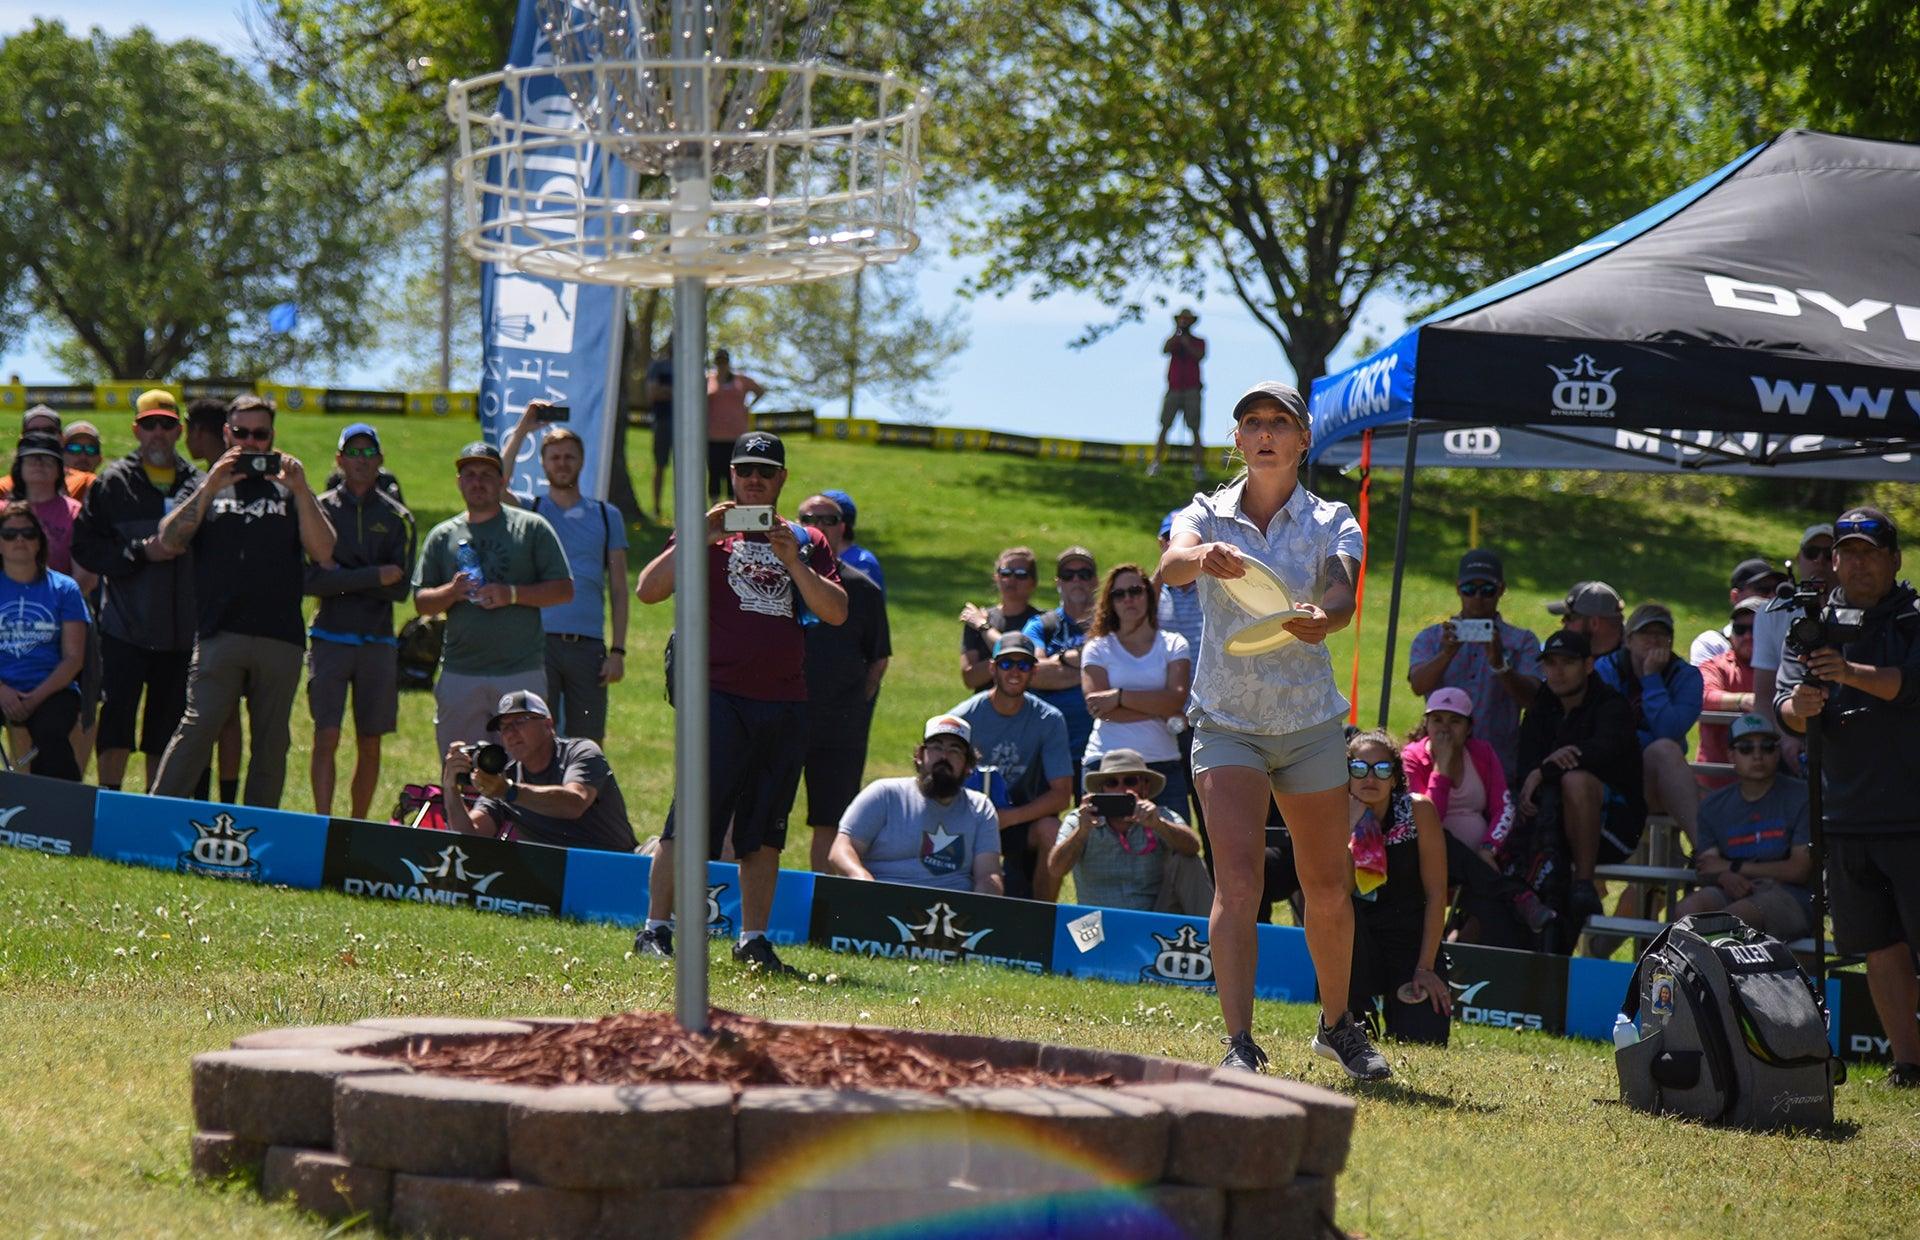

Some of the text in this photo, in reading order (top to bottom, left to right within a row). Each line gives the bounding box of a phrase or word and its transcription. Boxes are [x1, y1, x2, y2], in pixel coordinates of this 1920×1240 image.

[1704, 273, 1920, 341] DY
[1749, 375, 1920, 419] WW
[343, 878, 551, 917] DYNAMIC DISCS
[830, 936, 958, 966] DYNAMIC
[1728, 944, 1775, 965] ALLEN
[1462, 1006, 1544, 1031] DISCS
[1851, 1034, 1892, 1055] DY
